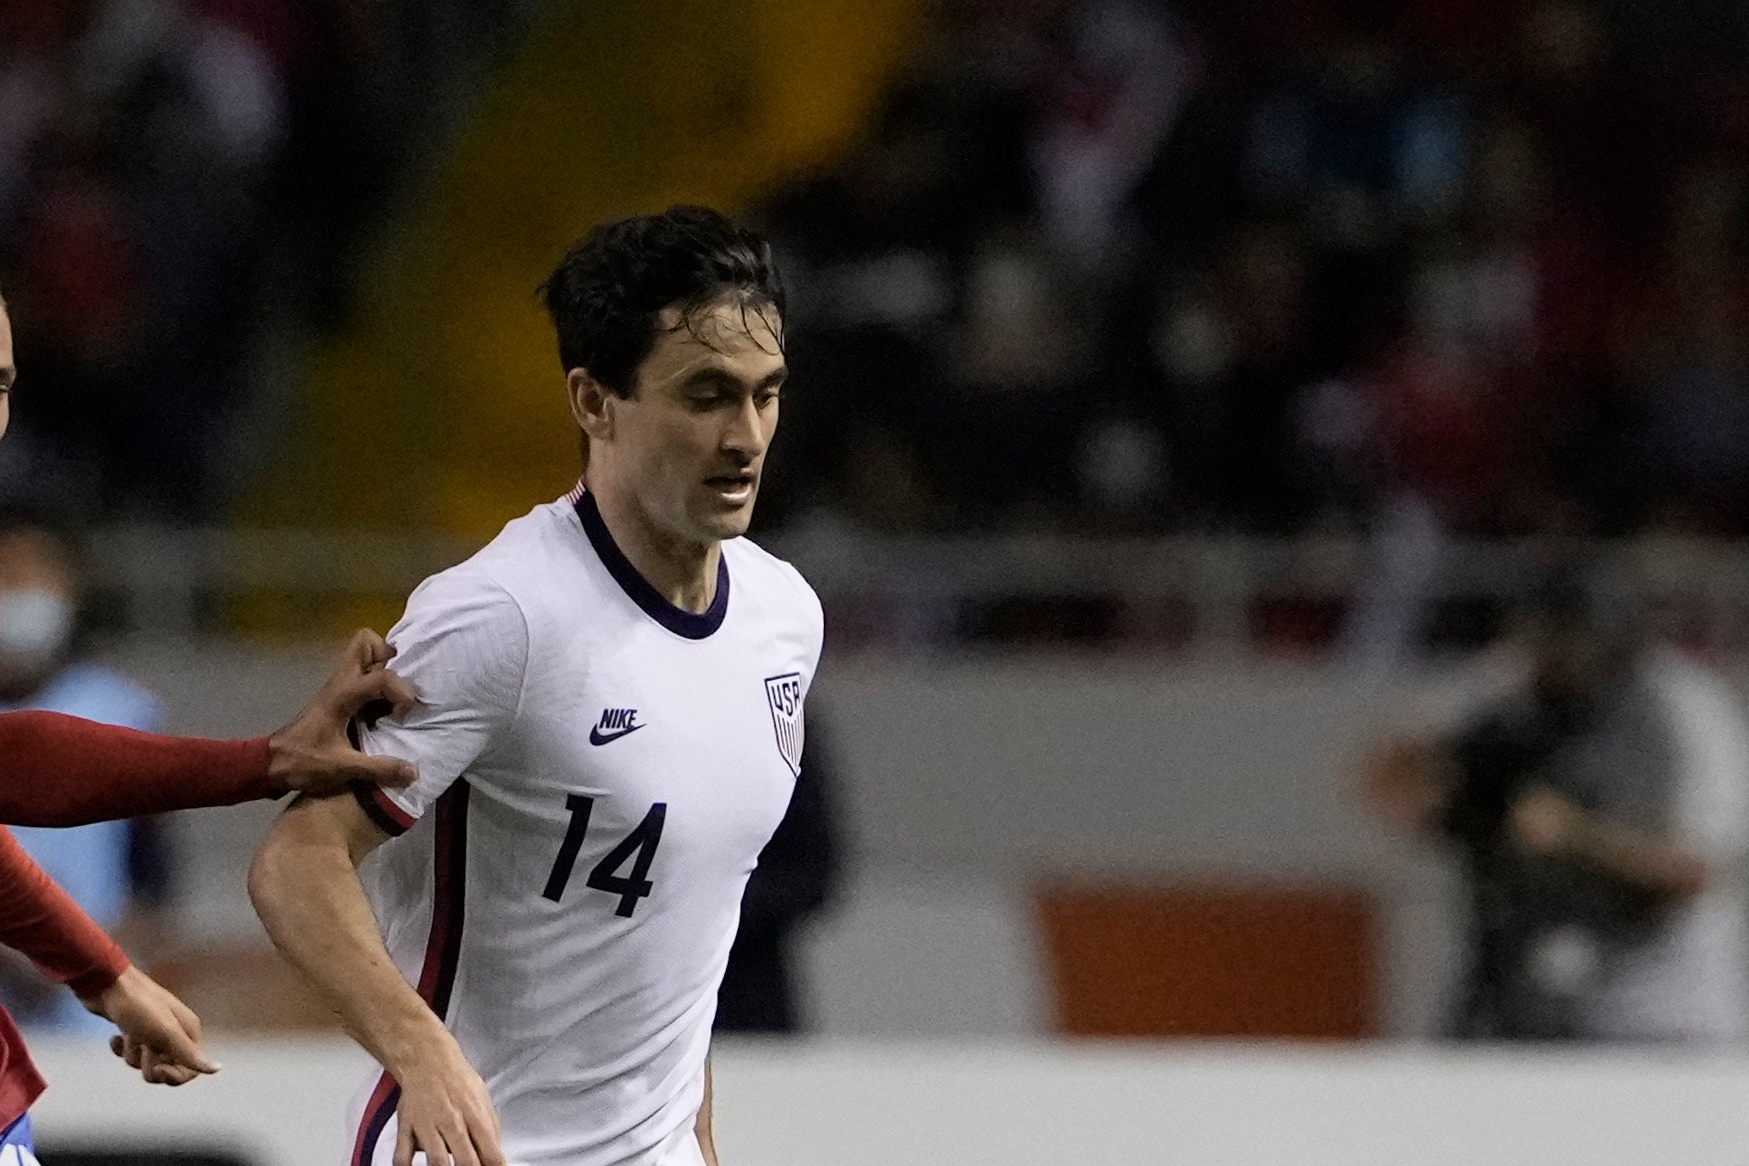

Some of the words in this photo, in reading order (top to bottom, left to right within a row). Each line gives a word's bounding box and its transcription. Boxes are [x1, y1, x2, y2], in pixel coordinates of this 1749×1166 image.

[770, 679, 801, 717] USA
[599, 708, 639, 730] NIKE
[541, 794, 668, 918] 14
